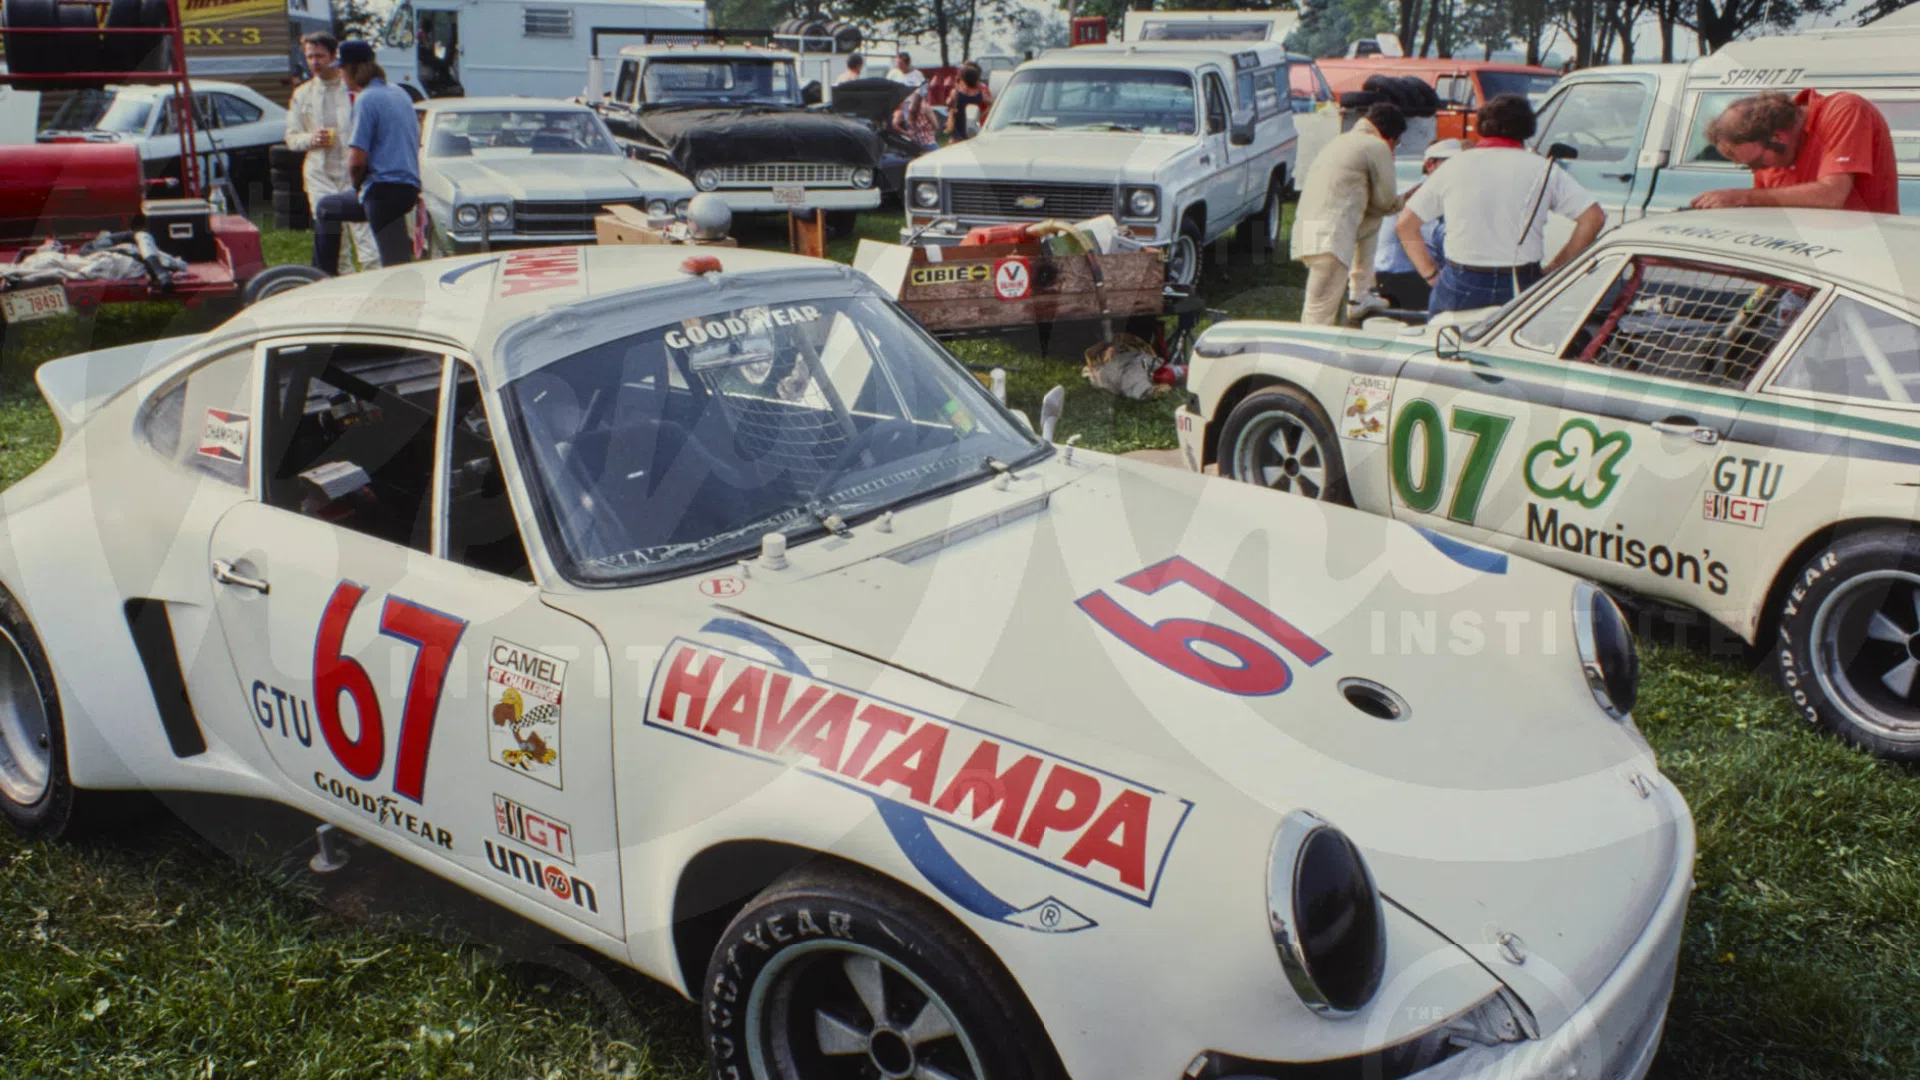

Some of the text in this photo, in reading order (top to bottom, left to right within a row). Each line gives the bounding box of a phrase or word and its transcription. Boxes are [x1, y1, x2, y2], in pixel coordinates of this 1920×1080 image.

[1720, 68, 1787, 85] SPIRIT
[1351, 376, 1390, 391] CAMEL
[1391, 397, 1516, 526] 07
[1714, 456, 1784, 501] GTU
[1730, 499, 1765, 522] GT
[1527, 502, 1730, 596] Morrison's
[1073, 554, 1334, 697] 67
[312, 578, 470, 806] 67
[493, 645, 561, 686] CAMEL
[252, 679, 312, 748] GTU
[656, 646, 1153, 892] HAVATAMPA
[314, 771, 453, 850] GOODYEAR
[525, 813, 568, 853] GT
